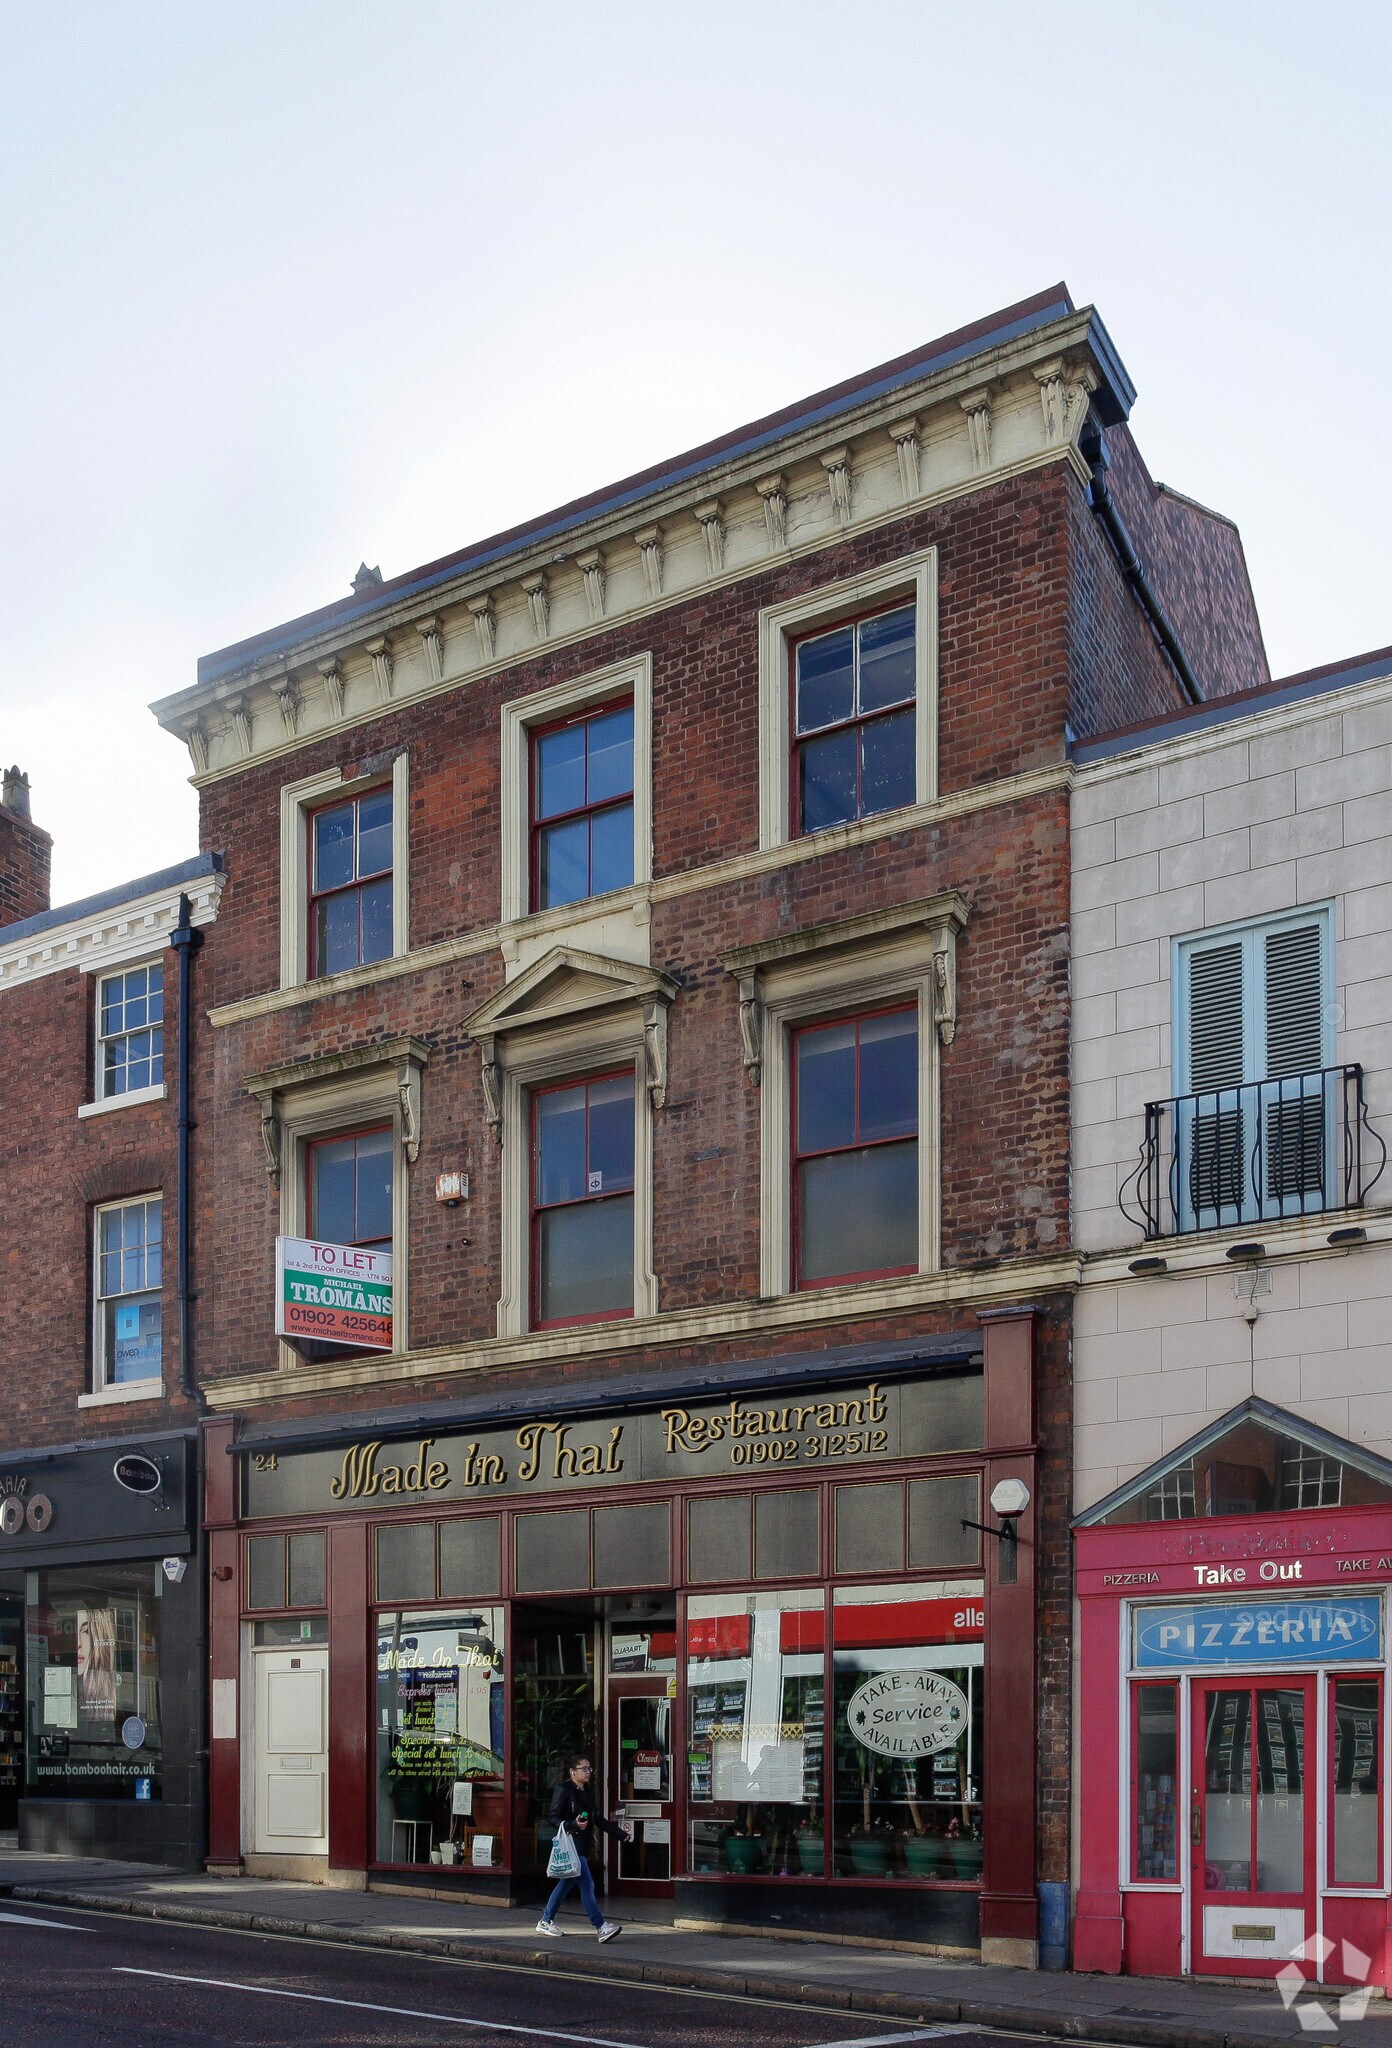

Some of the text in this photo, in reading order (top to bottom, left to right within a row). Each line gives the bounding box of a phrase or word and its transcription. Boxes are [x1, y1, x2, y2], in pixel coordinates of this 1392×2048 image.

[310, 1245, 376, 1270] TO LET
[314, 1264, 334, 1272] FLOOR
[336, 1267, 360, 1277] OFFICES
[324, 1278, 363, 1290] MICHAEL
[290, 1282, 393, 1315] TROMANS
[290, 1307, 393, 1335] 01902 425646
[660, 1382, 888, 1453] Restaurant
[730, 1430, 888, 1465] 01902 312512
[254, 1453, 279, 1472] 24
[329, 1421, 625, 1500] Made in Thai
[1193, 1559, 1303, 1585] Take Out
[1335, 1558, 1371, 1571] TAKE
[1103, 1571, 1160, 1586] PIZZERIA
[1160, 1616, 1353, 1649] PIZZERIA
[378, 1645, 500, 1673] Made In Thai
[398, 1684, 432, 1700] Express
[859, 1675, 902, 1706] TAKE
[914, 1676, 958, 1704] AWAY
[414, 1712, 437, 1725] lunch
[872, 1702, 943, 1725] Service
[400, 1732, 430, 1749] Special
[863, 1724, 953, 1752] AVAILABLE
[391, 1746, 423, 1762] Special
[424, 1746, 438, 1759] set
[440, 1746, 462, 1759] lunch
[637, 1751, 659, 1763] Closed
[37, 1763, 155, 1776] www.bamboohair.co.uk
